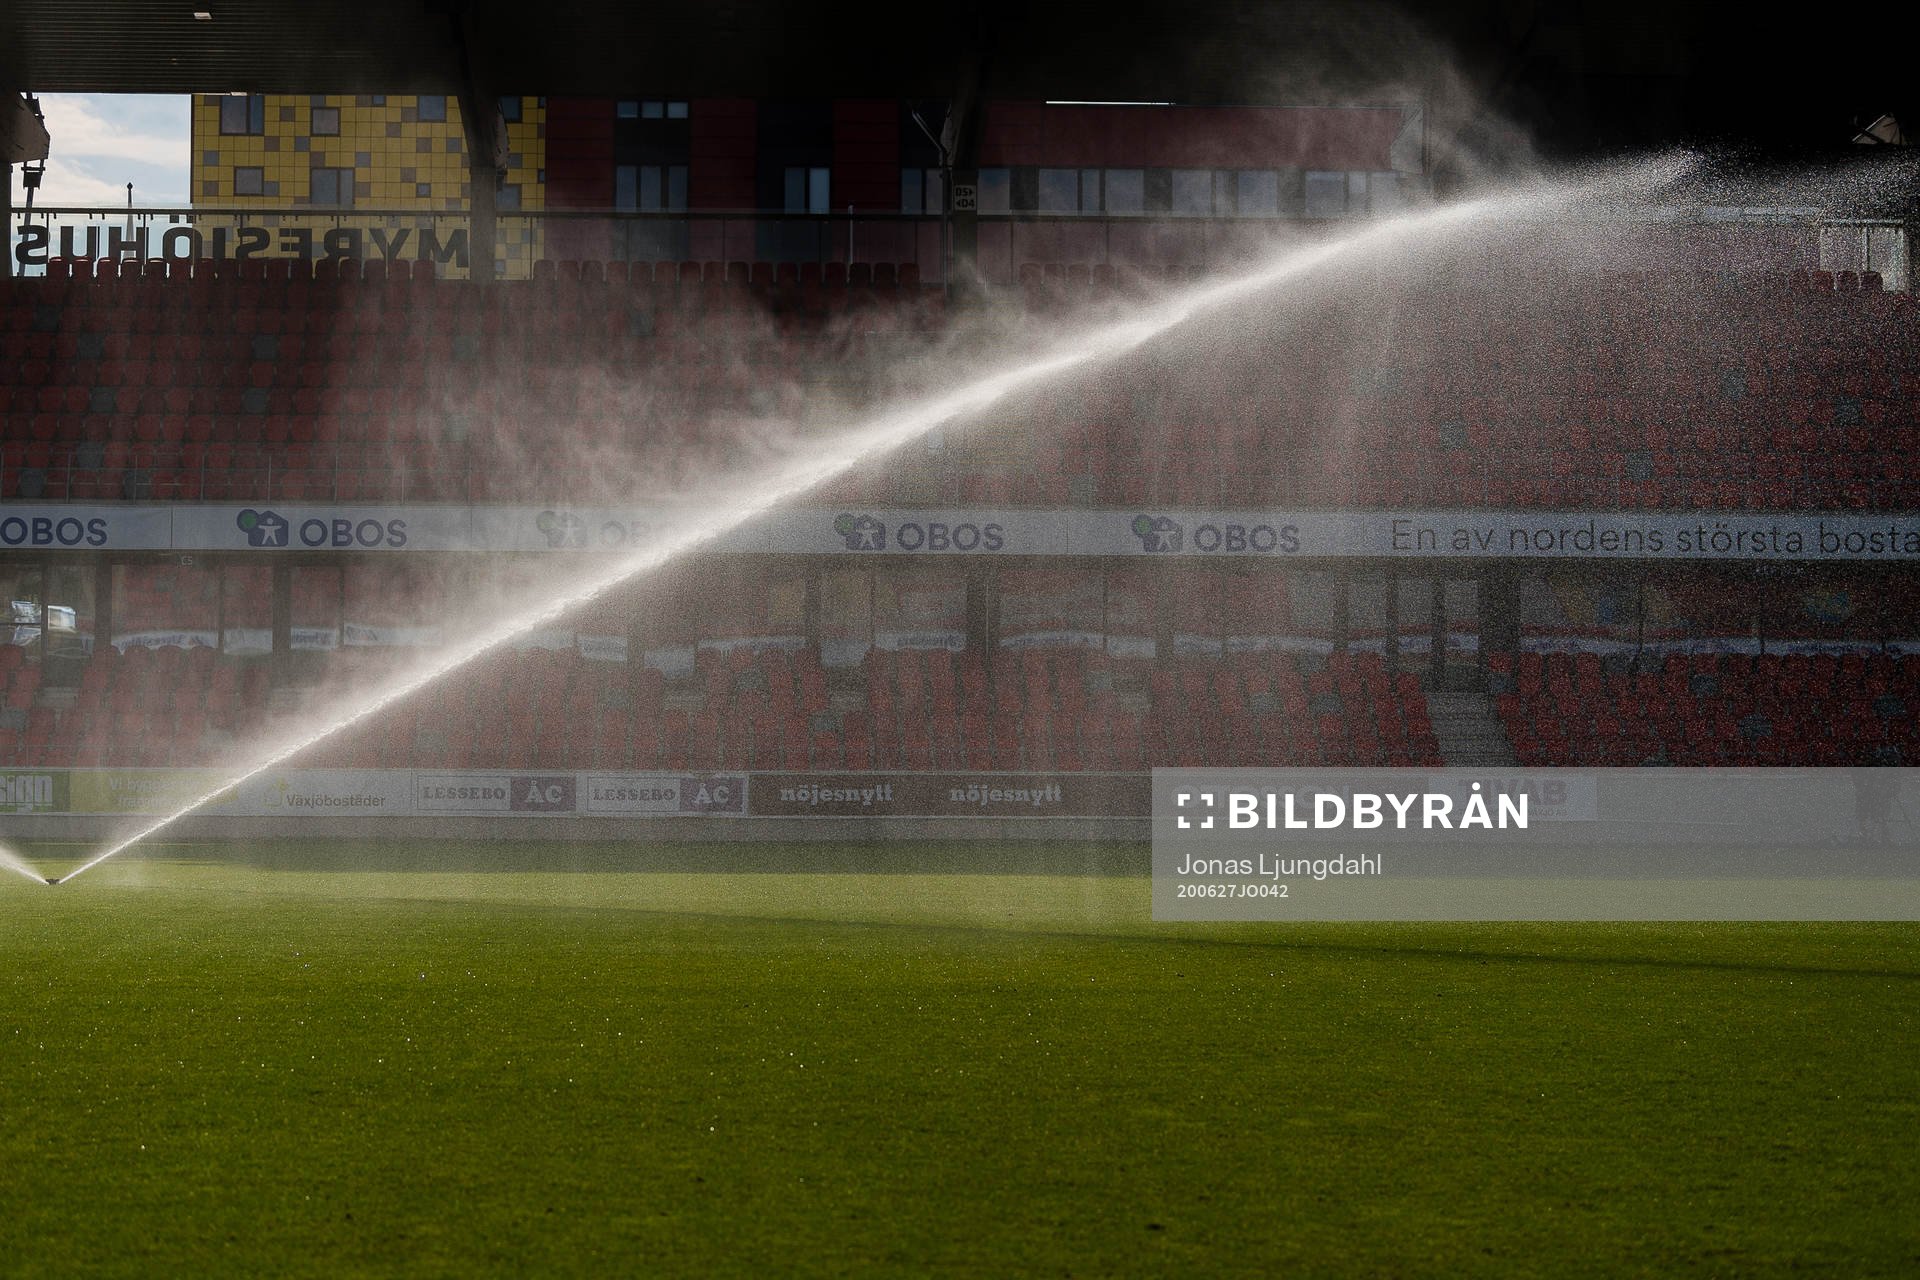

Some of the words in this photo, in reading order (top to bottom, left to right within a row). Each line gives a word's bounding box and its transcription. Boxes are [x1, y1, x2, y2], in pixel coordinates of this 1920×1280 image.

[0, 516, 108, 546] OBOS
[300, 518, 407, 547] OBOS
[897, 522, 1004, 551] OBOS
[1194, 523, 1300, 553] OBOS
[1392, 519, 1437, 551] En
[1452, 528, 1494, 551] av
[1509, 519, 1664, 552] nordens
[1676, 522, 1801, 553] största
[1820, 521, 1920, 554] bosta
[286, 793, 386, 809] Växjöbostäder
[423, 786, 506, 800] LESSEBO
[593, 788, 677, 801] LESSEBO
[780, 783, 895, 806] nöjesnytt
[950, 783, 1062, 806] nöjesnytt
